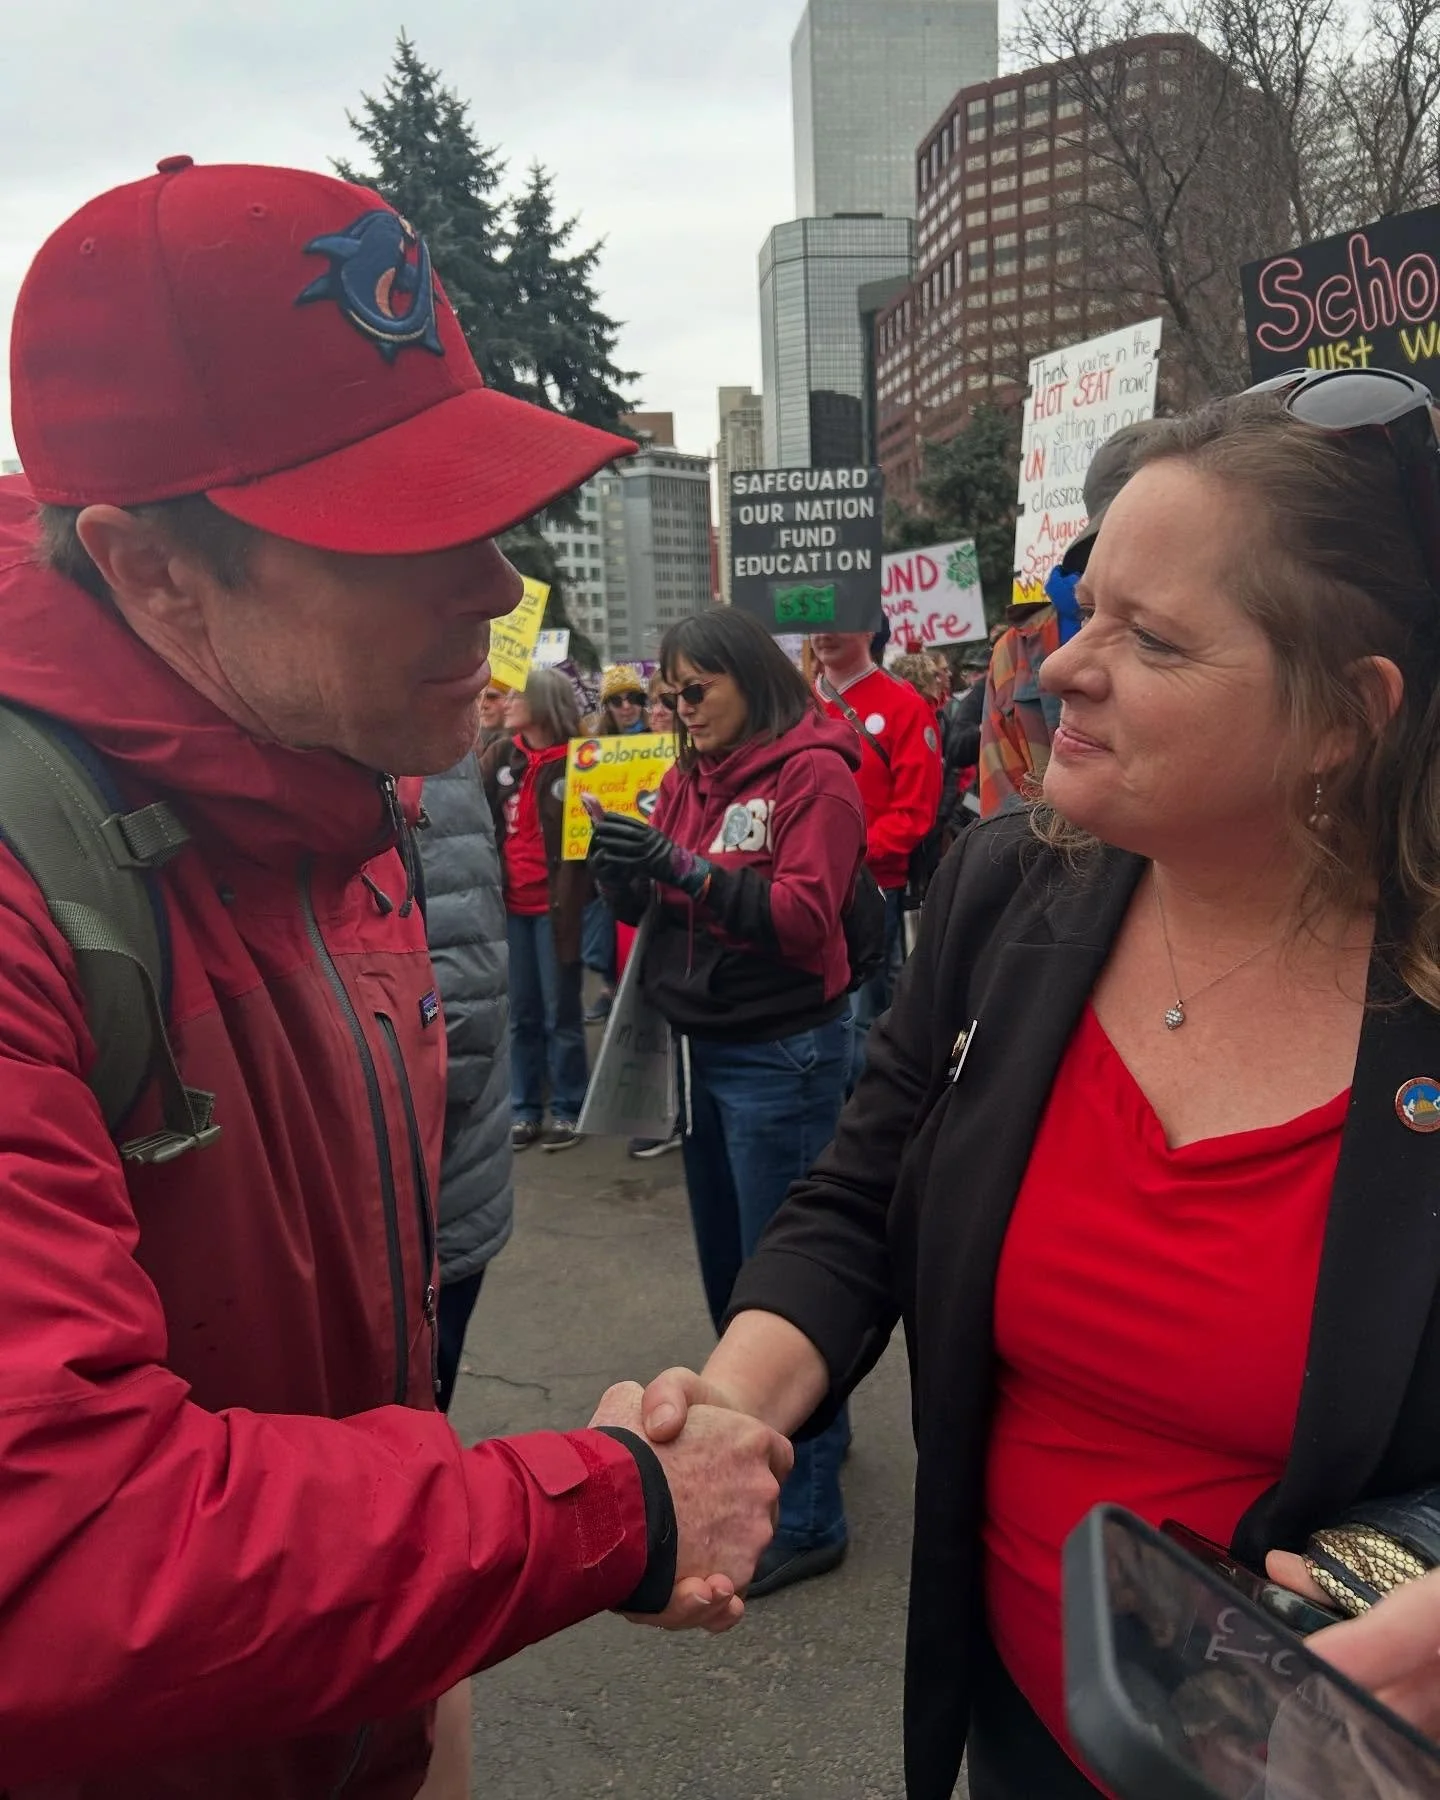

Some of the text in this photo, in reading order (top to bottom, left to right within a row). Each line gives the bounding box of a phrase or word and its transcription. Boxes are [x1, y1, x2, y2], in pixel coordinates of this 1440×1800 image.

[1256, 233, 1439, 352] Scho
[1133, 330, 1151, 357] the
[1034, 381, 1070, 421] HOT
[1073, 367, 1115, 407] SEAT
[1053, 410, 1096, 446] sitting
[1103, 410, 1118, 433] in
[1025, 448, 1045, 482] UN
[732, 468, 868, 495] SAFEGUARD
[739, 497, 874, 525] OUR NATION
[779, 526, 836, 548] FUND
[734, 549, 872, 577] EDUCATION
[574, 736, 676, 772] Colorado
